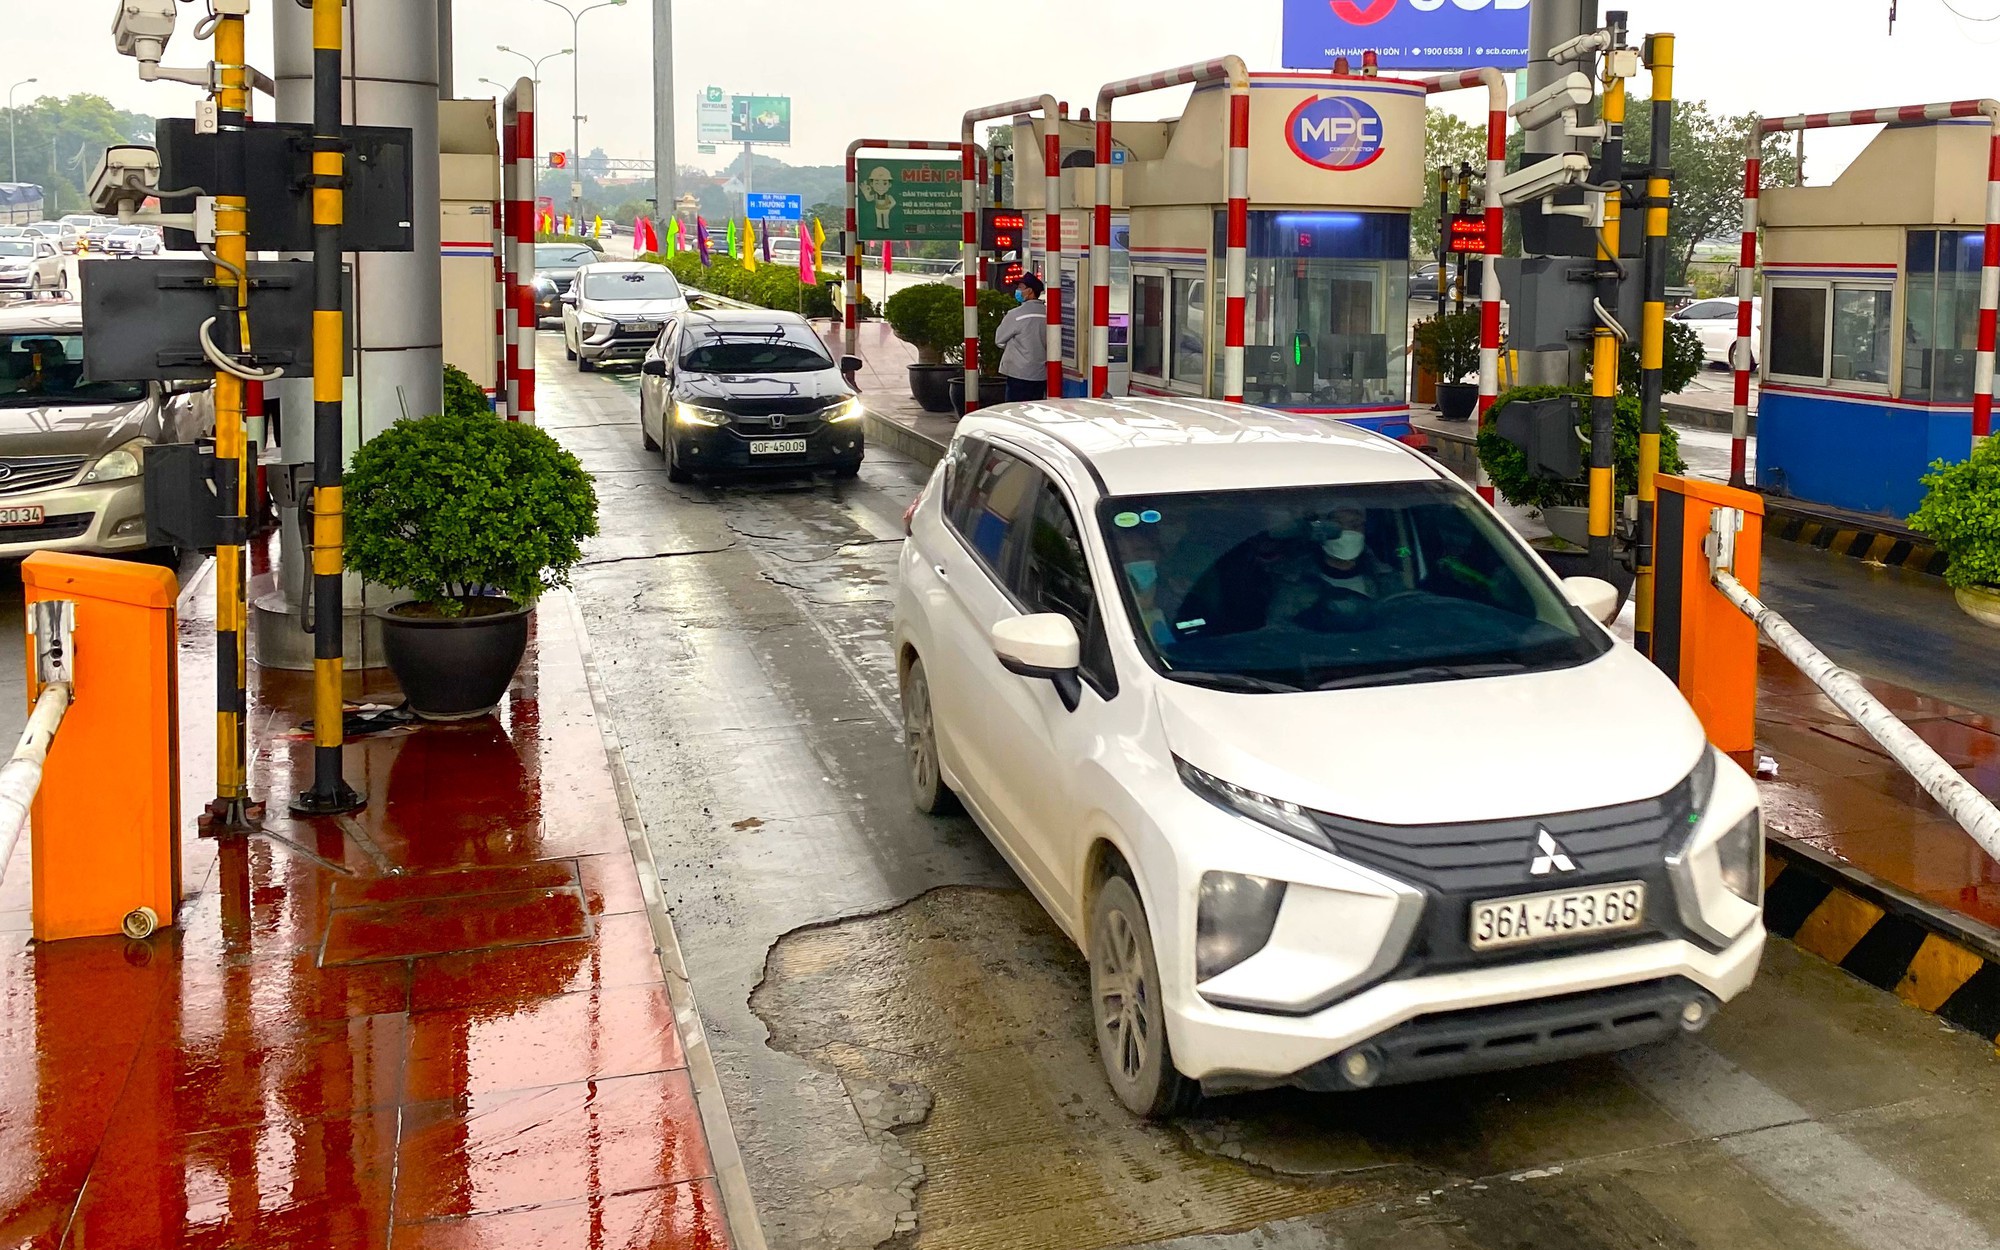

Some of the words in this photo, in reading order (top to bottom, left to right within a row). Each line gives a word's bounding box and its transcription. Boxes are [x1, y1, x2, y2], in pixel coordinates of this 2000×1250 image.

[1324, 46, 1346, 56] NGÂN
[1383, 46, 1400, 56] GÒN
[1423, 47, 1442, 56] 1900
[1443, 47, 1463, 56] 6538
[1301, 117, 1377, 142] MPC
[751, 441, 805, 453] 30F-450.09
[1477, 889, 1639, 942] 36A-453.68
